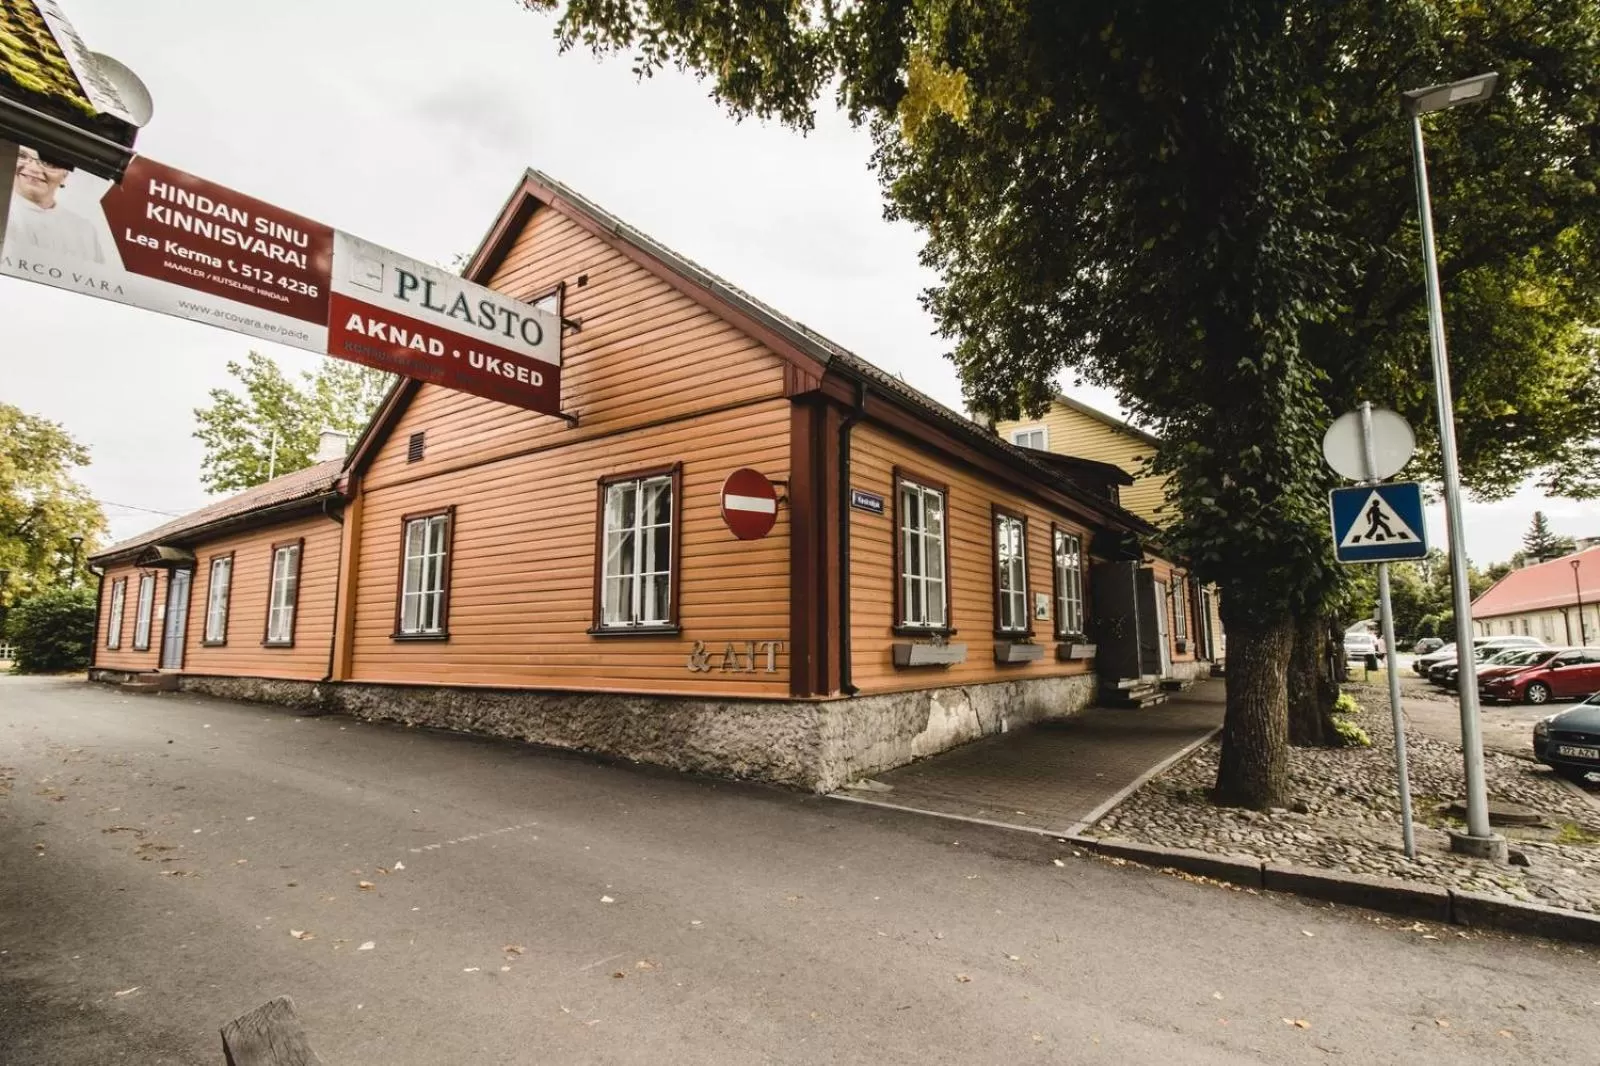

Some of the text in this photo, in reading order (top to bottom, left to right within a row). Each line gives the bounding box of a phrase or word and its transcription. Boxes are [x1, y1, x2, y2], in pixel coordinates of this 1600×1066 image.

[146, 202, 307, 270] KINNISVARA!
[149, 179, 308, 248] HINDAN SINU
[3, 256, 125, 296] ARCO VARA
[125, 228, 319, 298] Lea Kerma 512 4236
[164, 260, 206, 279] MAAKLER
[212, 274, 256, 295] KUTSELINE
[257, 286, 290, 303] HINDAJA
[178, 299, 310, 342] www.arcovara.ee/paide
[393, 267, 544, 347] PLASTO
[345, 313, 445, 357] AKNAD
[469, 350, 544, 387] UKSED
[687, 640, 784, 674] & AIT
